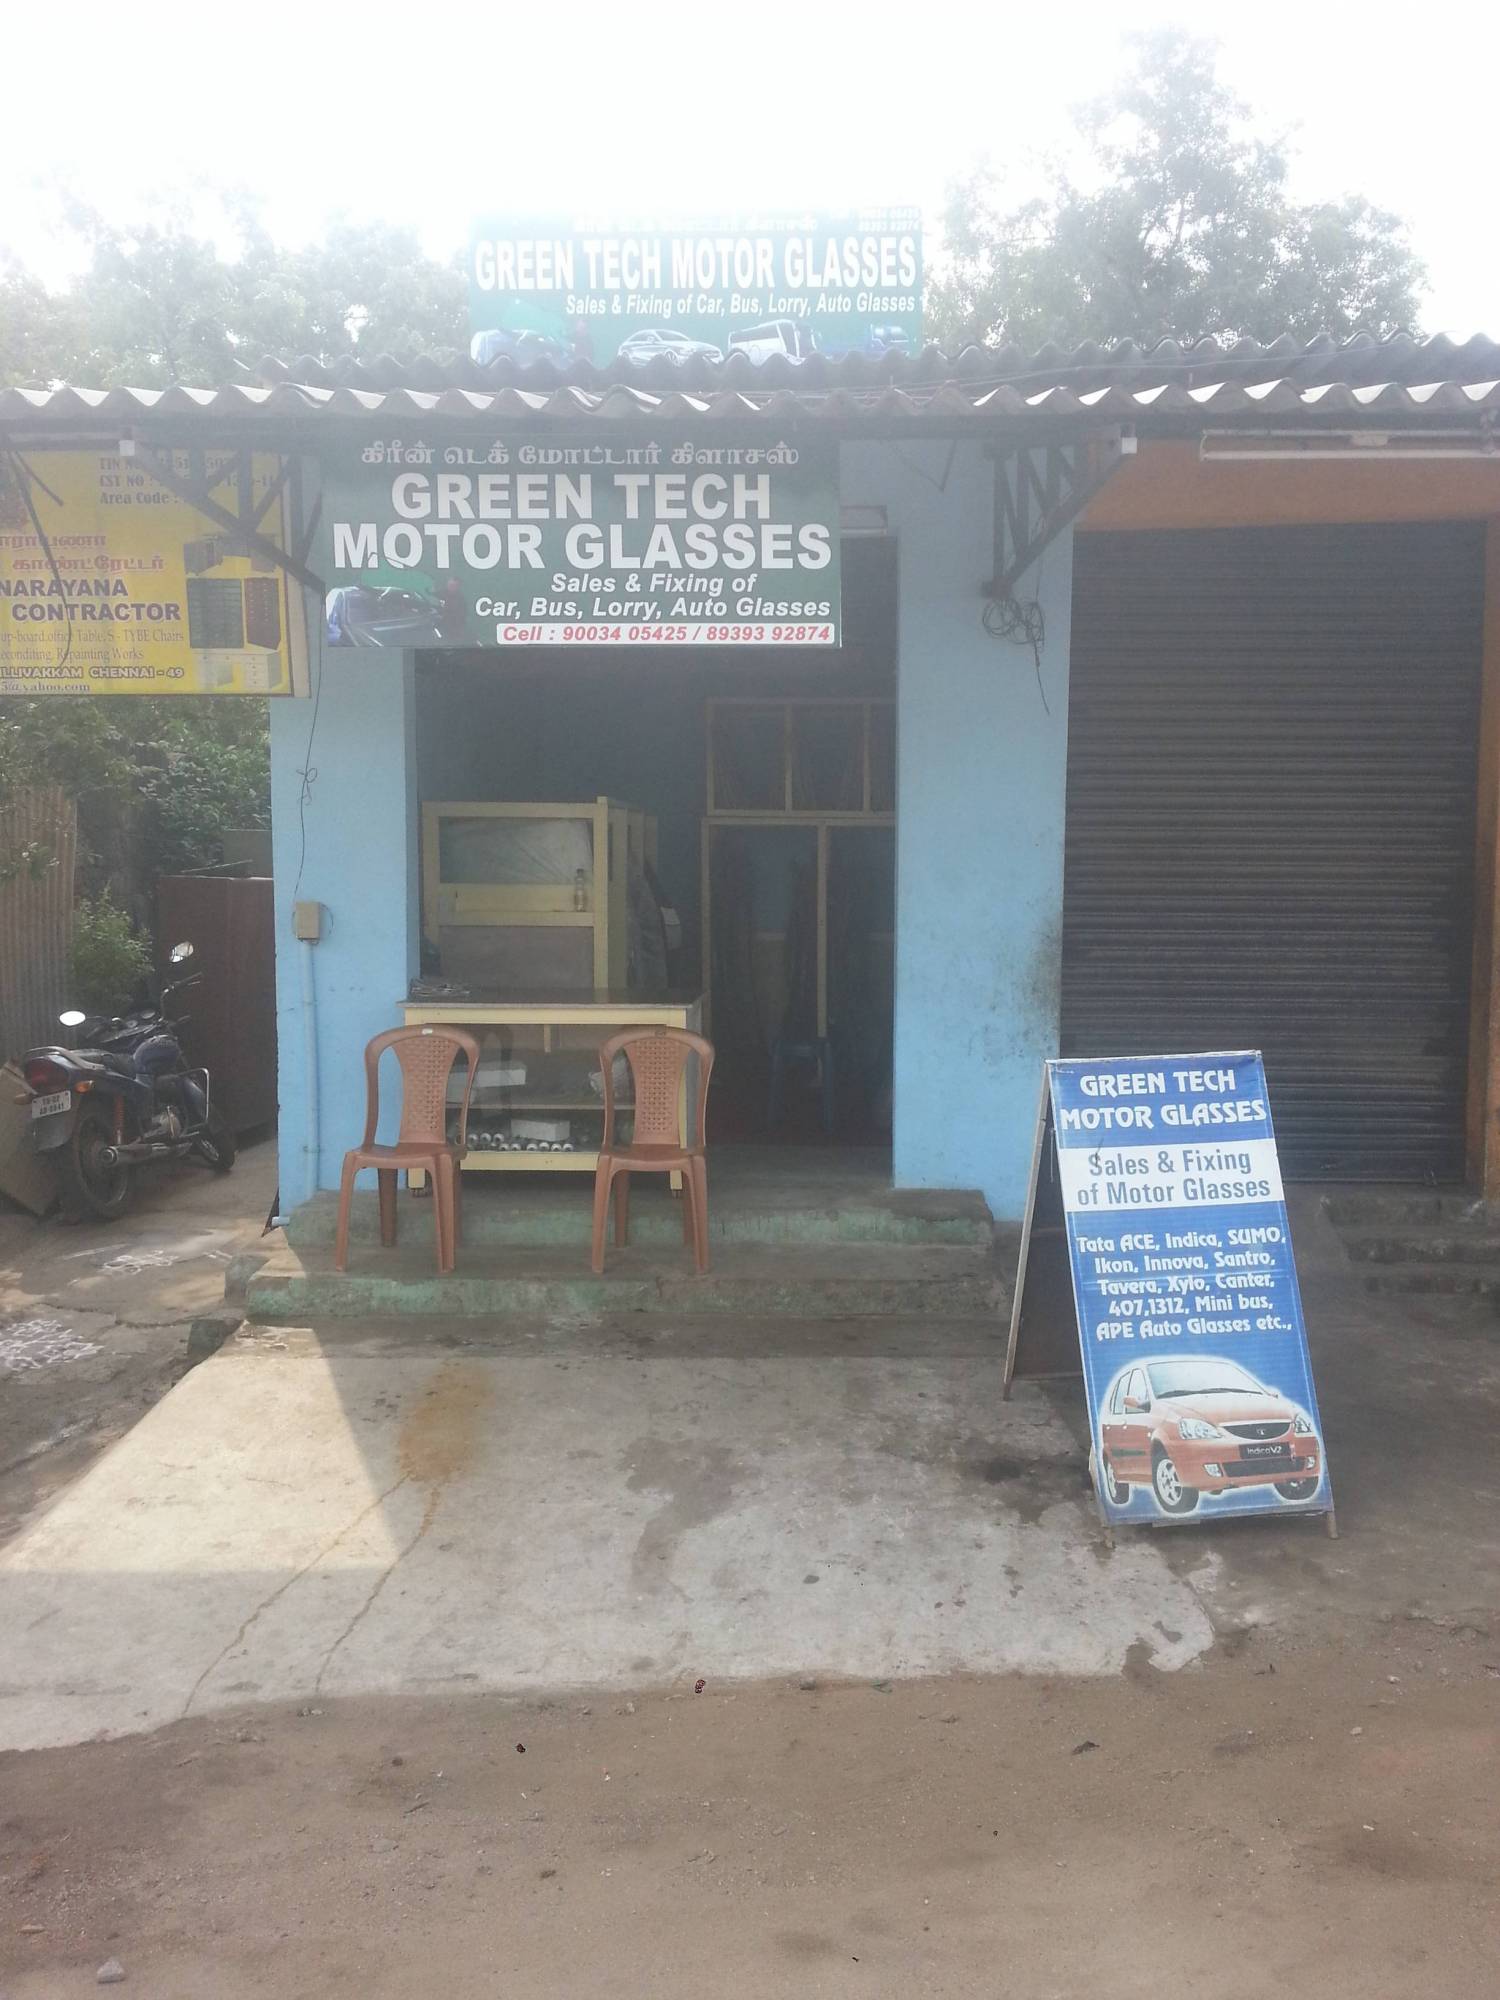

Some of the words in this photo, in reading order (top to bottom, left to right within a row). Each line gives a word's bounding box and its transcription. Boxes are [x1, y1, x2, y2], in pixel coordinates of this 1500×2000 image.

[475, 239, 574, 290] GREEN
[583, 238, 661, 289] TECH
[672, 238, 775, 288] MOTOR
[784, 237, 917, 288] GLASSES
[566, 295, 606, 314] Sales
[611, 296, 622, 313] &
[627, 294, 672, 318] Fixing
[677, 294, 693, 313] of
[697, 294, 725, 316] Car,
[730, 294, 762, 316] Bus,
[768, 294, 811, 317] Lorry,
[816, 294, 851, 313] Auto
[856, 293, 915, 312] Glasses
[444, 439, 510, 465] டெக்
[518, 440, 662, 465] மோட்டார்
[671, 440, 799, 465] கிளாசஸ்
[101, 492, 132, 504] Area
[136, 492, 168, 504] Code
[392, 473, 592, 520] GREEN
[614, 473, 770, 520] TECH
[333, 523, 543, 570] MOTOR
[565, 523, 832, 571] GLASSES
[0, 579, 129, 597] NARAYANA
[551, 573, 616, 593] Sales
[625, 574, 642, 593] &
[649, 573, 723, 597] Fixing
[731, 572, 758, 593] of
[12, 603, 181, 621] CONTRACTOR
[475, 597, 521, 620] Car,
[530, 597, 583, 620] Bus,
[592, 597, 662, 621] Lorry,
[670, 597, 728, 617] Auto
[735, 597, 831, 617] Glasses
[503, 626, 542, 641] Cell
[563, 626, 621, 641] 90034
[628, 626, 687, 641] 05425
[706, 626, 765, 641] 89393
[771, 625, 830, 641] 92874
[112, 648, 144, 660] Works
[89, 666, 155, 679] CHENNAI
[166, 667, 184, 678] 49
[1080, 1072, 1166, 1098] GREEN
[1173, 1070, 1236, 1093] TECH
[1060, 1105, 1154, 1130] MOTOR
[1160, 1099, 1267, 1127] GLASSES
[1088, 1153, 1149, 1177] Sales
[1158, 1150, 1175, 1173] &
[1182, 1149, 1252, 1174] Fixing
[1077, 1183, 1098, 1205] of
[1107, 1181, 1174, 1205] Motor
[1183, 1178, 1270, 1201] Glasses
[1076, 1236, 1115, 1253] Tata
[1120, 1233, 1160, 1252] ACE,
[1165, 1231, 1222, 1250] Indica,
[1227, 1228, 1286, 1245] SUMO,
[1095, 1257, 1138, 1274] Ikon,
[1144, 1255, 1208, 1271] Innova,
[1215, 1251, 1275, 1268] Santro,
[1097, 1279, 1161, 1296] Tavera,
[1167, 1276, 1210, 1294] Xylo,
[1215, 1272, 1274, 1289] Canter,
[1195, 1295, 1232, 1313] Mini
[1239, 1294, 1273, 1310] bus,
[1096, 1322, 1134, 1341] APE
[1139, 1319, 1182, 1338] Auto
[1187, 1317, 1250, 1334] Glasses
